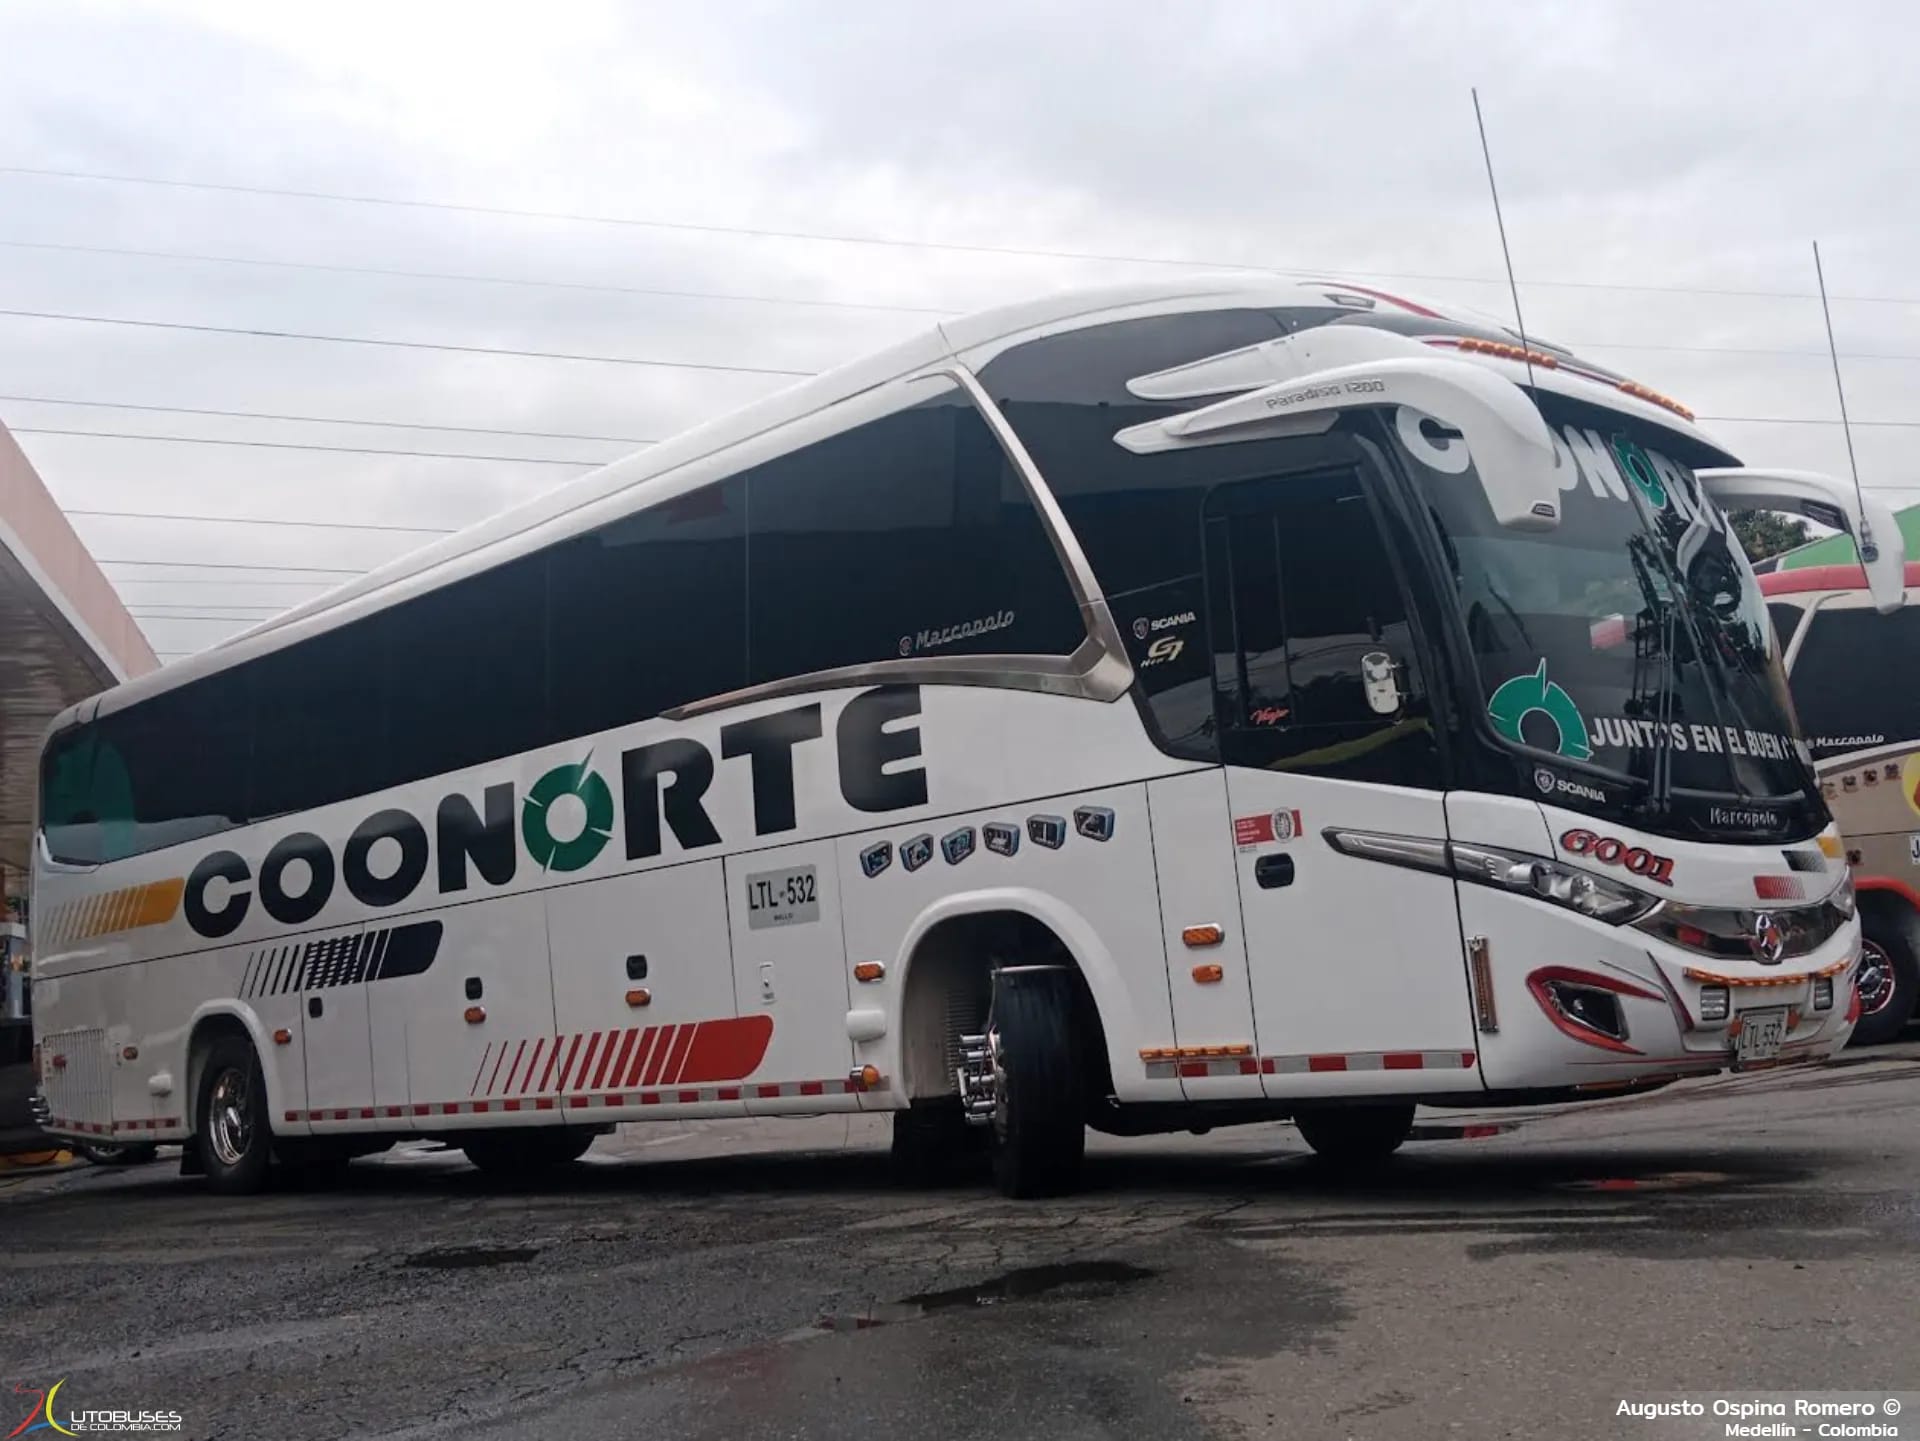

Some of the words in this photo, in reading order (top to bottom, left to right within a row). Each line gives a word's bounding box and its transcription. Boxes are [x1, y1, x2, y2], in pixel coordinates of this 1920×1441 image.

[1264, 386, 1341, 410] Paradiso
[1345, 379, 1385, 393] 1200
[915, 609, 1015, 651] Marcopolo
[1151, 611, 1196, 631] SCANIA
[1690, 723, 1724, 752] EN
[1725, 726, 1747, 755] EL
[1745, 730, 1784, 760] BUEN
[1816, 733, 1885, 748] Marcopolo
[1556, 778, 1607, 804] SCANIA
[184, 683, 929, 938] COONORTE
[1710, 807, 1778, 828] Marcopolo
[1558, 827, 1675, 888] 6001
